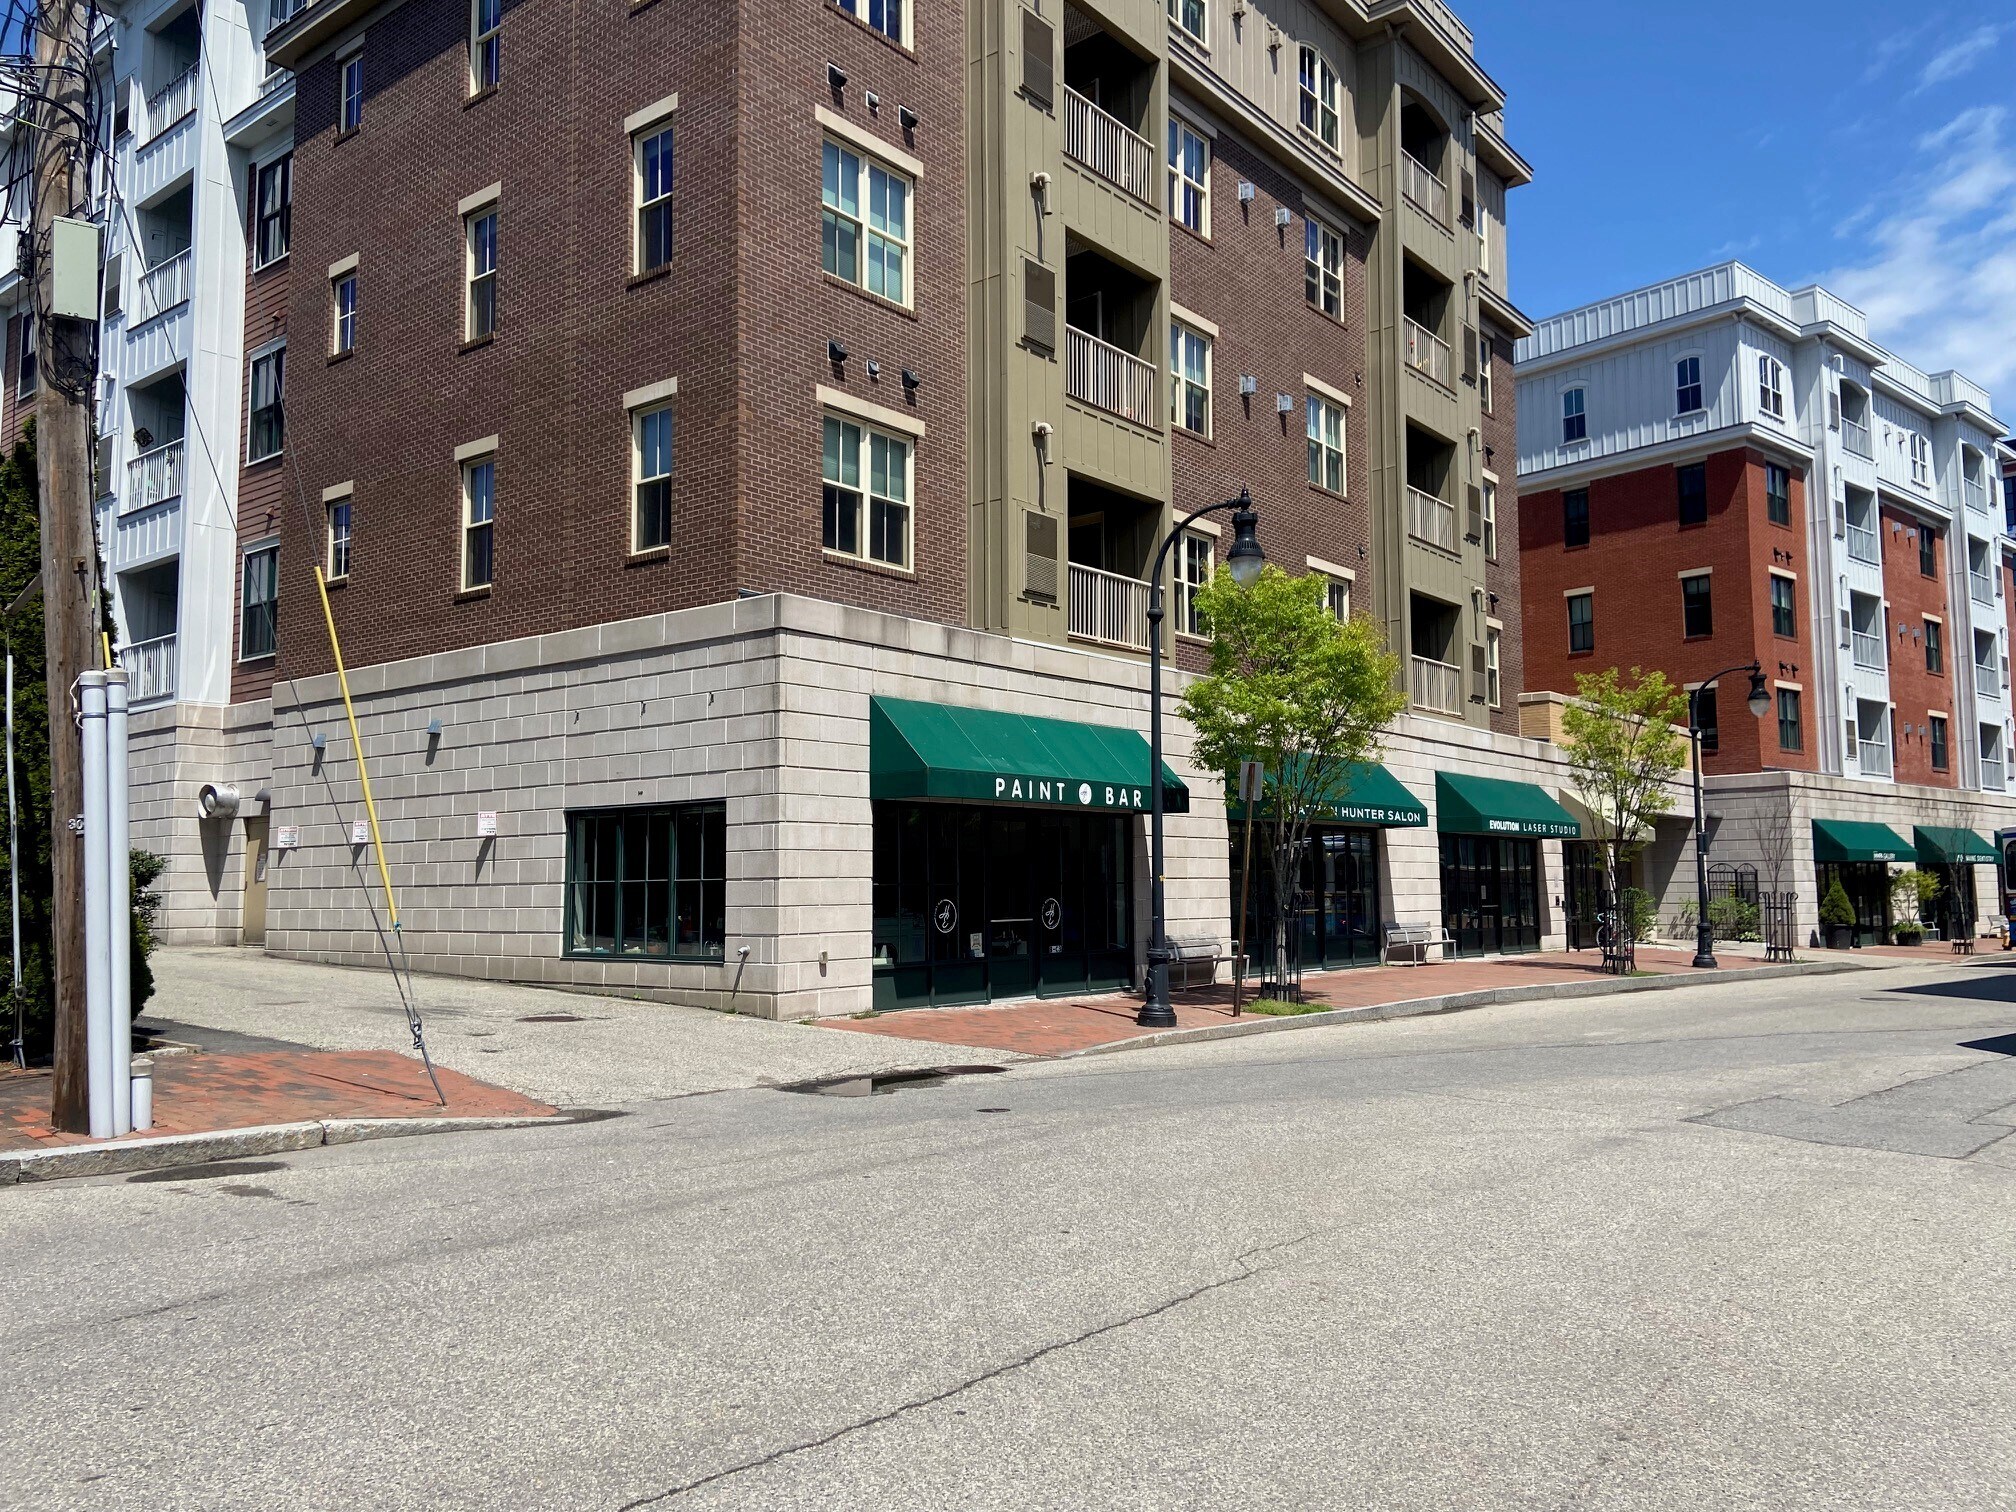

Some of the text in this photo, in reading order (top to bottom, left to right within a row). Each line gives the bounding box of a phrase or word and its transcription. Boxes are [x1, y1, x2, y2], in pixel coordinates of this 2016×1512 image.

[995, 777, 1142, 808] PAINT BAR
[1341, 806, 1384, 820] HUNTER
[1387, 810, 1421, 822] SALON
[1489, 819, 1576, 836] EVOLUTION LASER STUDIO
